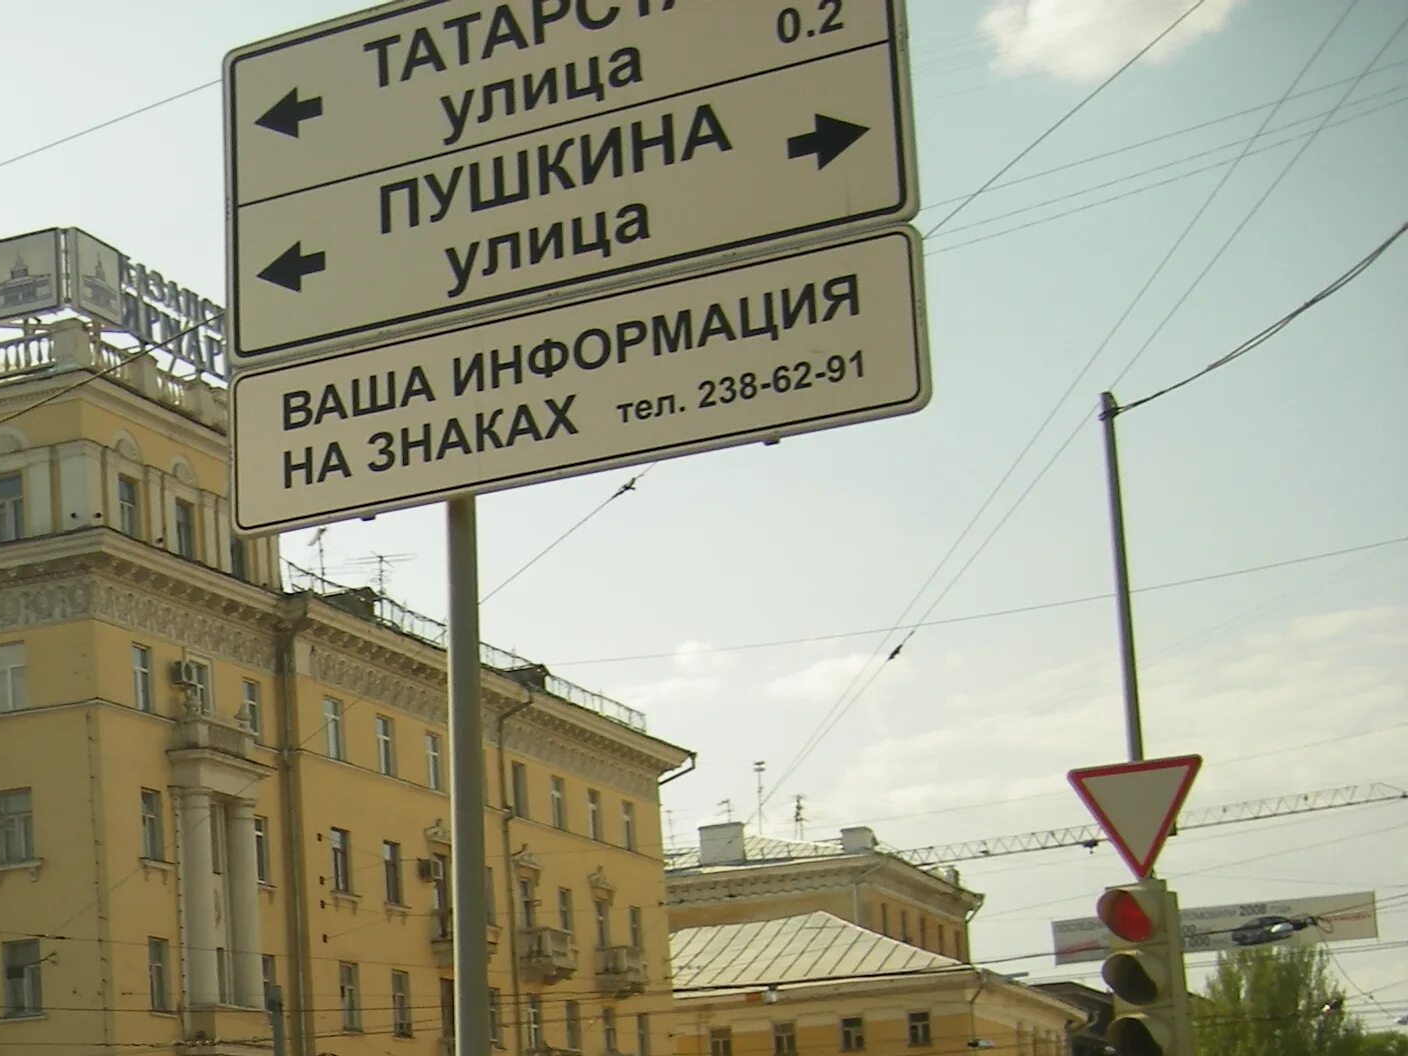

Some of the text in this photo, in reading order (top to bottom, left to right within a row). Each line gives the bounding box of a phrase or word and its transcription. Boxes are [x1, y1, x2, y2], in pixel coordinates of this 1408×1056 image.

[363, 0, 676, 88] ТАТАРС
[777, 0, 844, 44] 0.2
[440, 47, 644, 146] улица
[380, 104, 734, 235] ПУШКИНА
[444, 203, 651, 298] улица
[282, 274, 861, 432] ВАША ИНФОРМАЦИЯ
[283, 350, 866, 490] НА ЗНАКАХ тел. 238-62-91
